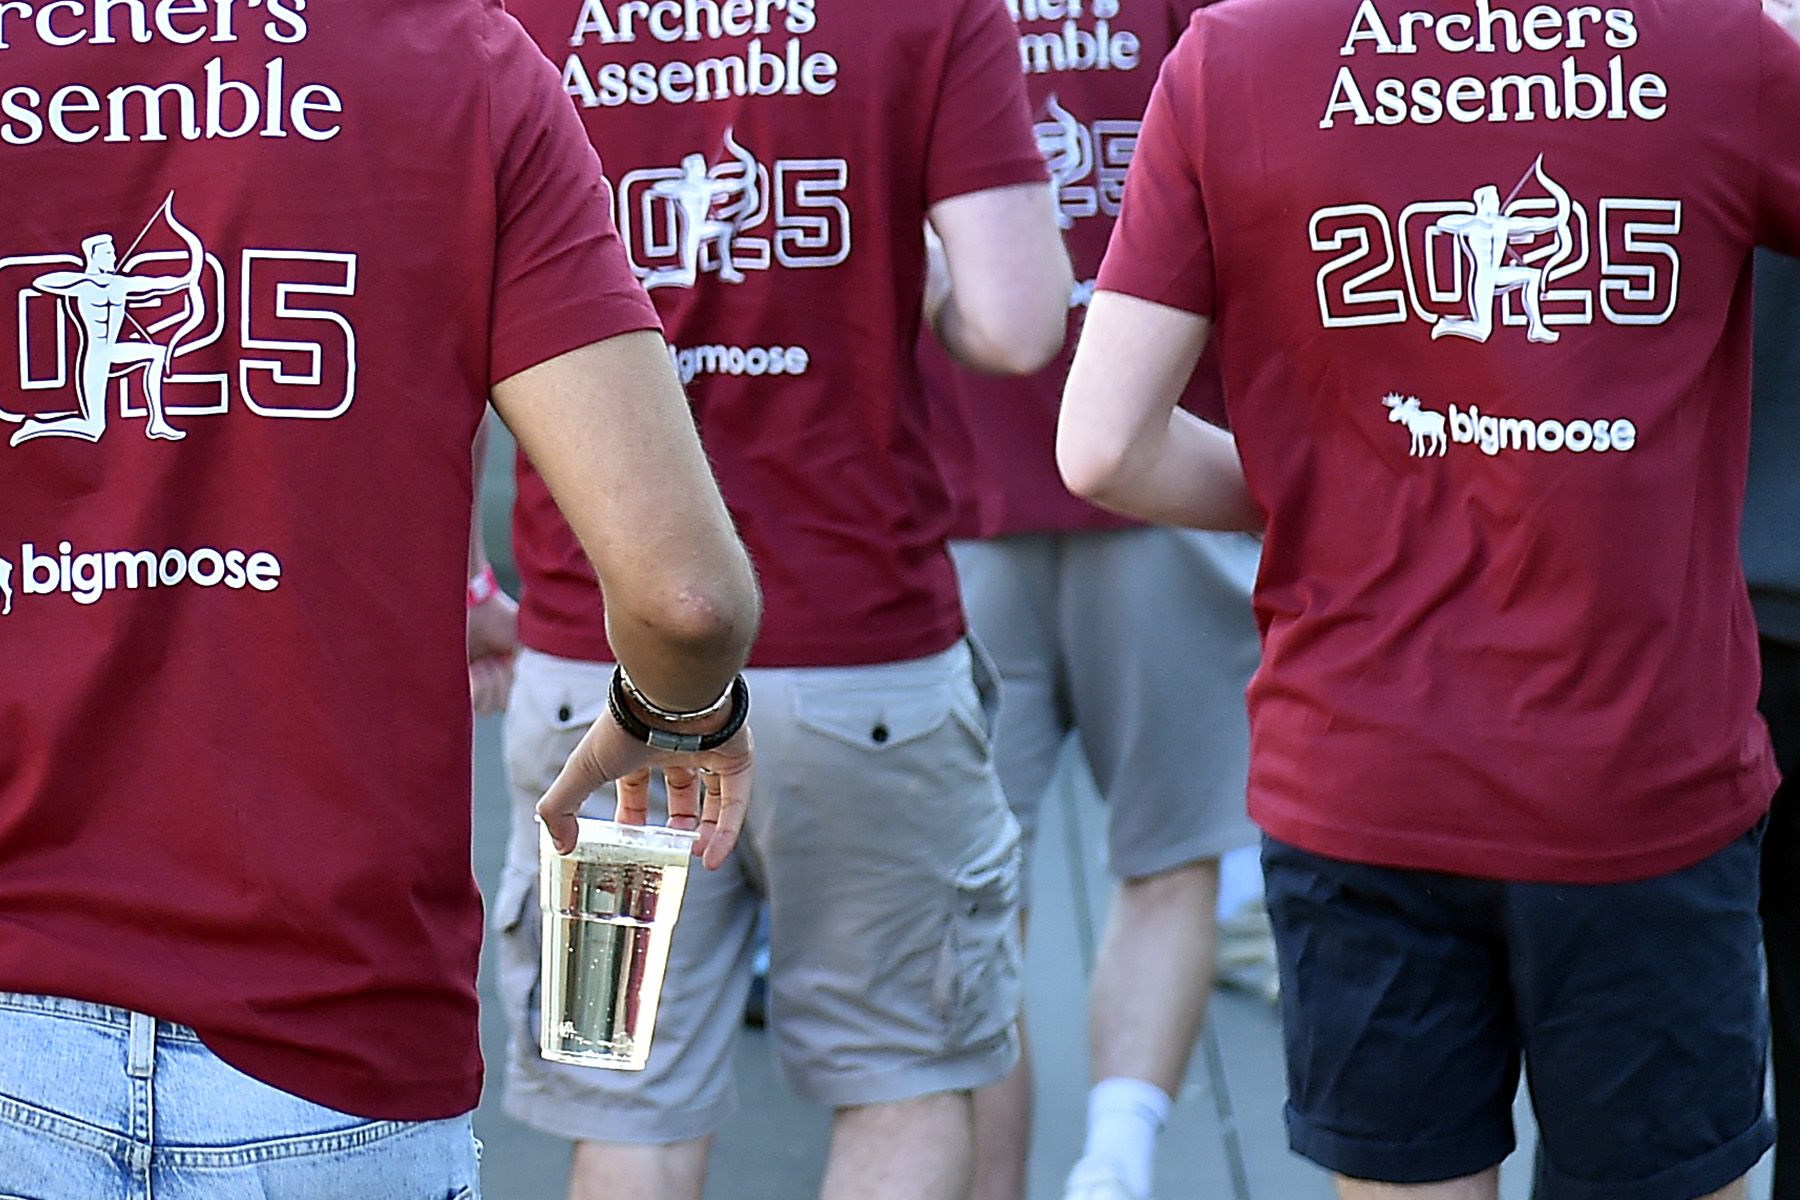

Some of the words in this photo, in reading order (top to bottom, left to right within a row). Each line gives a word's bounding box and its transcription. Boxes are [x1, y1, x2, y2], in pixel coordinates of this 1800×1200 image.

[562, 39, 838, 108] Assemble
[1019, 19, 1141, 73] mble
[1319, 55, 1668, 128] Assemble
[601, 158, 852, 278] 025
[1308, 199, 1682, 328] 2025
[1449, 404, 1637, 456] bigmoose
[22, 543, 281, 604] bigmoose
